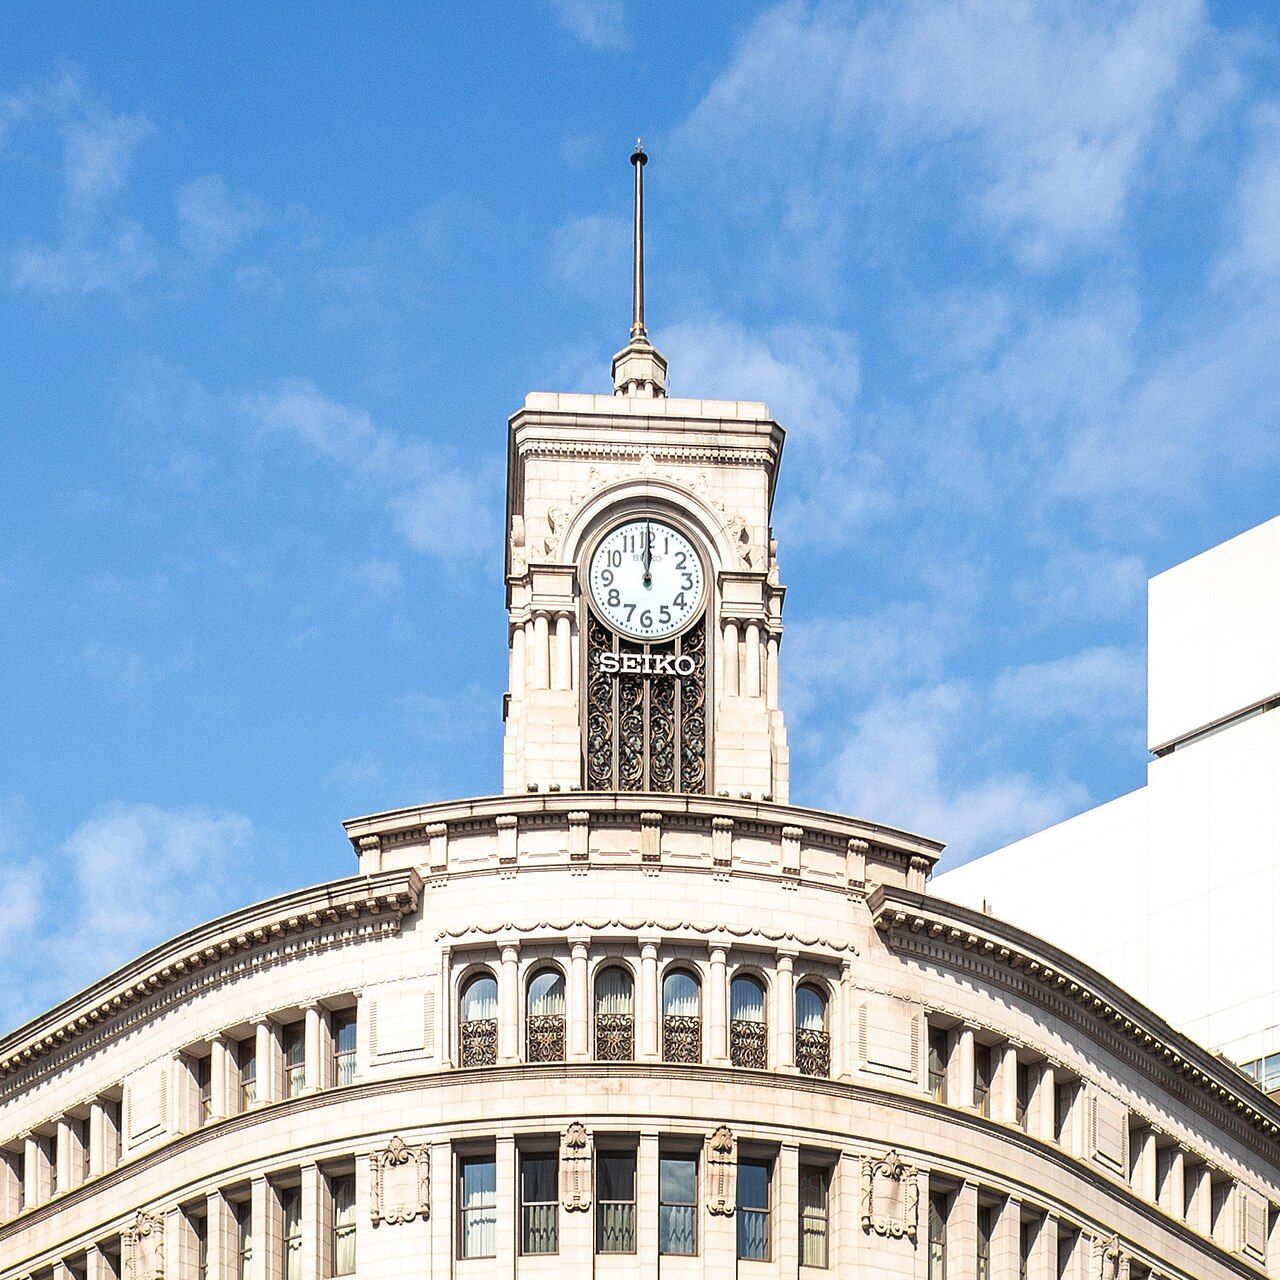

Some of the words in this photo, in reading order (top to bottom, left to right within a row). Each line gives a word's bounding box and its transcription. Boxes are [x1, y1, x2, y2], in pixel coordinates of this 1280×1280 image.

[623, 535, 635, 553] 11
[664, 537, 669, 555] 1
[607, 550, 622, 567] 10
[674, 552, 687, 570] 2
[601, 569, 614, 587] 9
[681, 573, 693, 591] 3
[607, 589, 620, 607] 8
[673, 592, 687, 610] 4
[623, 604, 636, 622] 7
[640, 610, 653, 628] 6
[658, 605, 671, 624] 5
[599, 652, 696, 676] SEIKO
